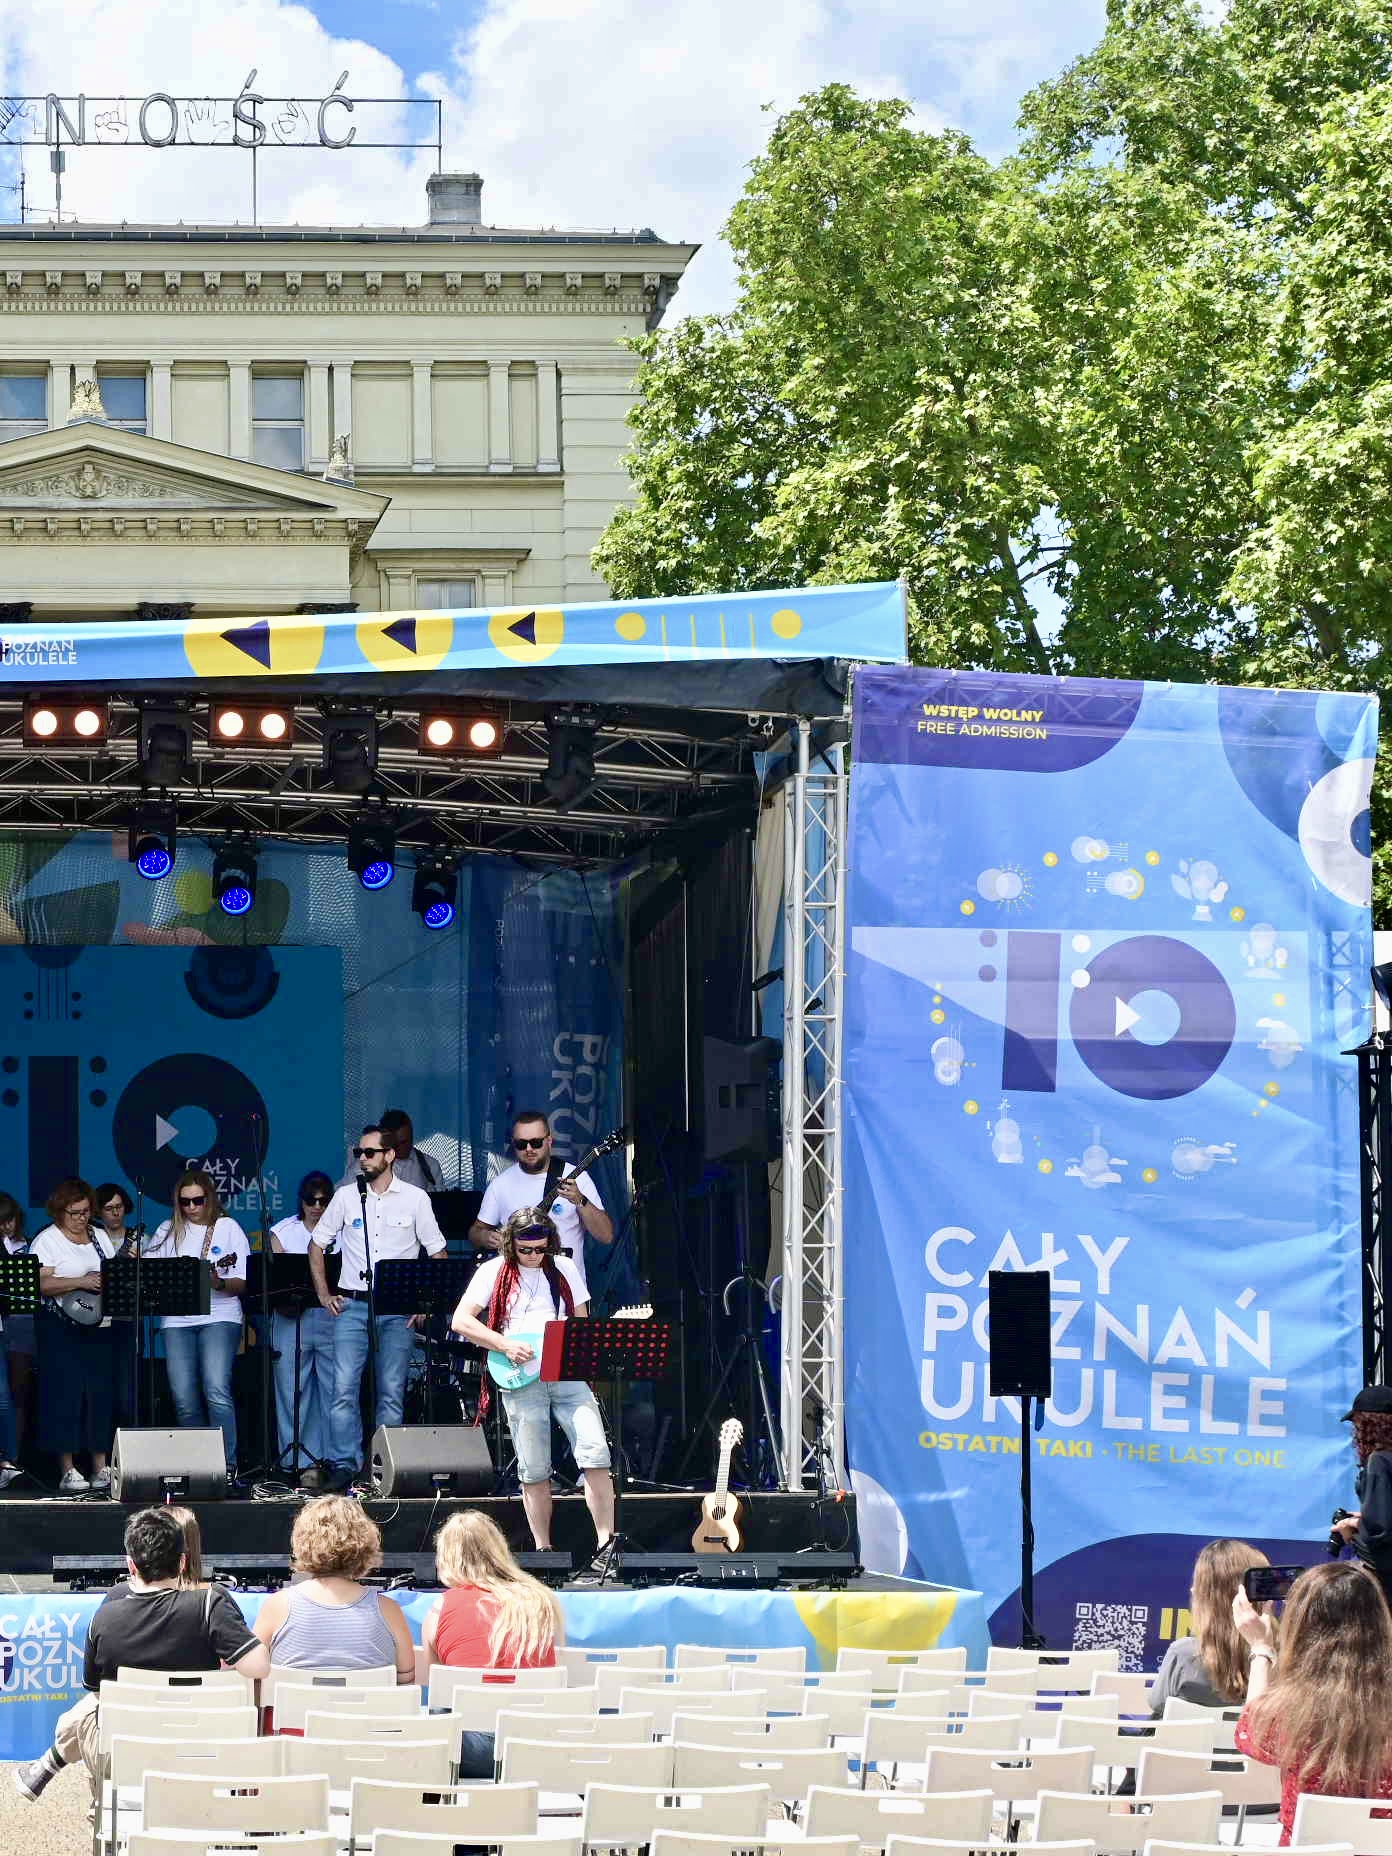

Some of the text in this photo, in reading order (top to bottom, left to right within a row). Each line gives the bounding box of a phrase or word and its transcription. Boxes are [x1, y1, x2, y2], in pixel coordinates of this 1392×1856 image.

[2, 651, 78, 666] UKULELE
[923, 704, 1044, 722] WSTĘP WOLNY
[917, 721, 1047, 740] FREE ADMISSION
[209, 1170, 278, 1192] ZNAŃ
[923, 1287, 1272, 1371] PZNAŃ
[918, 1431, 1288, 1469] OSTATN TAKI THE LAST ONE
[0, 1640, 85, 1666] POZN
